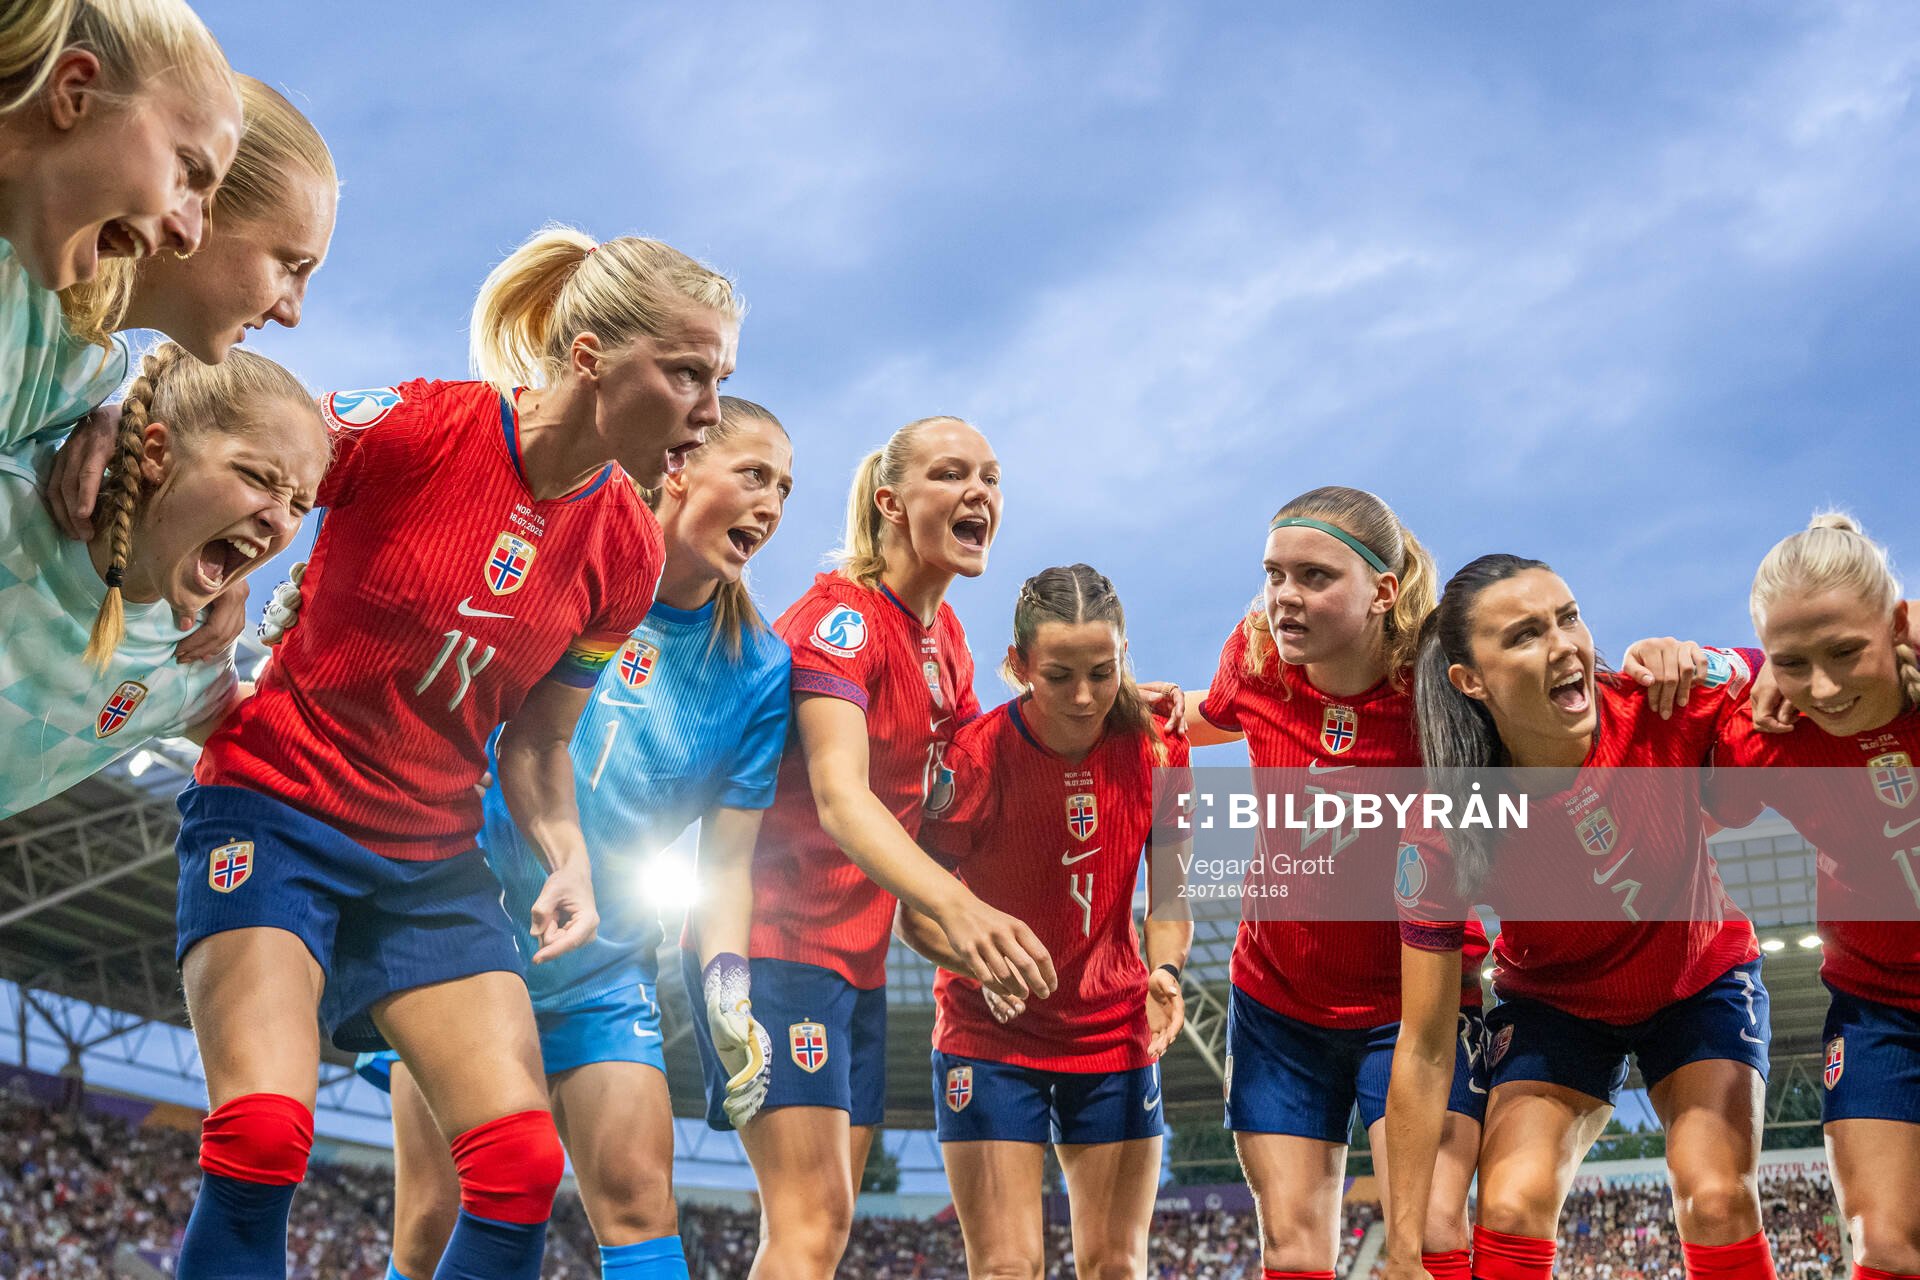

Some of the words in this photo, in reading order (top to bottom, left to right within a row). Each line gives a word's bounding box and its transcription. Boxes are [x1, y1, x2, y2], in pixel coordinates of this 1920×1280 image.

[515, 503, 531, 516] NOR
[534, 514, 545, 526] ITA
[414, 629, 497, 713] 14
[590, 719, 620, 793] 1
[1070, 873, 1093, 938] 4
[1611, 878, 1642, 925] 7
[1891, 845, 1920, 913] 1
[1734, 970, 1757, 1026] 7
